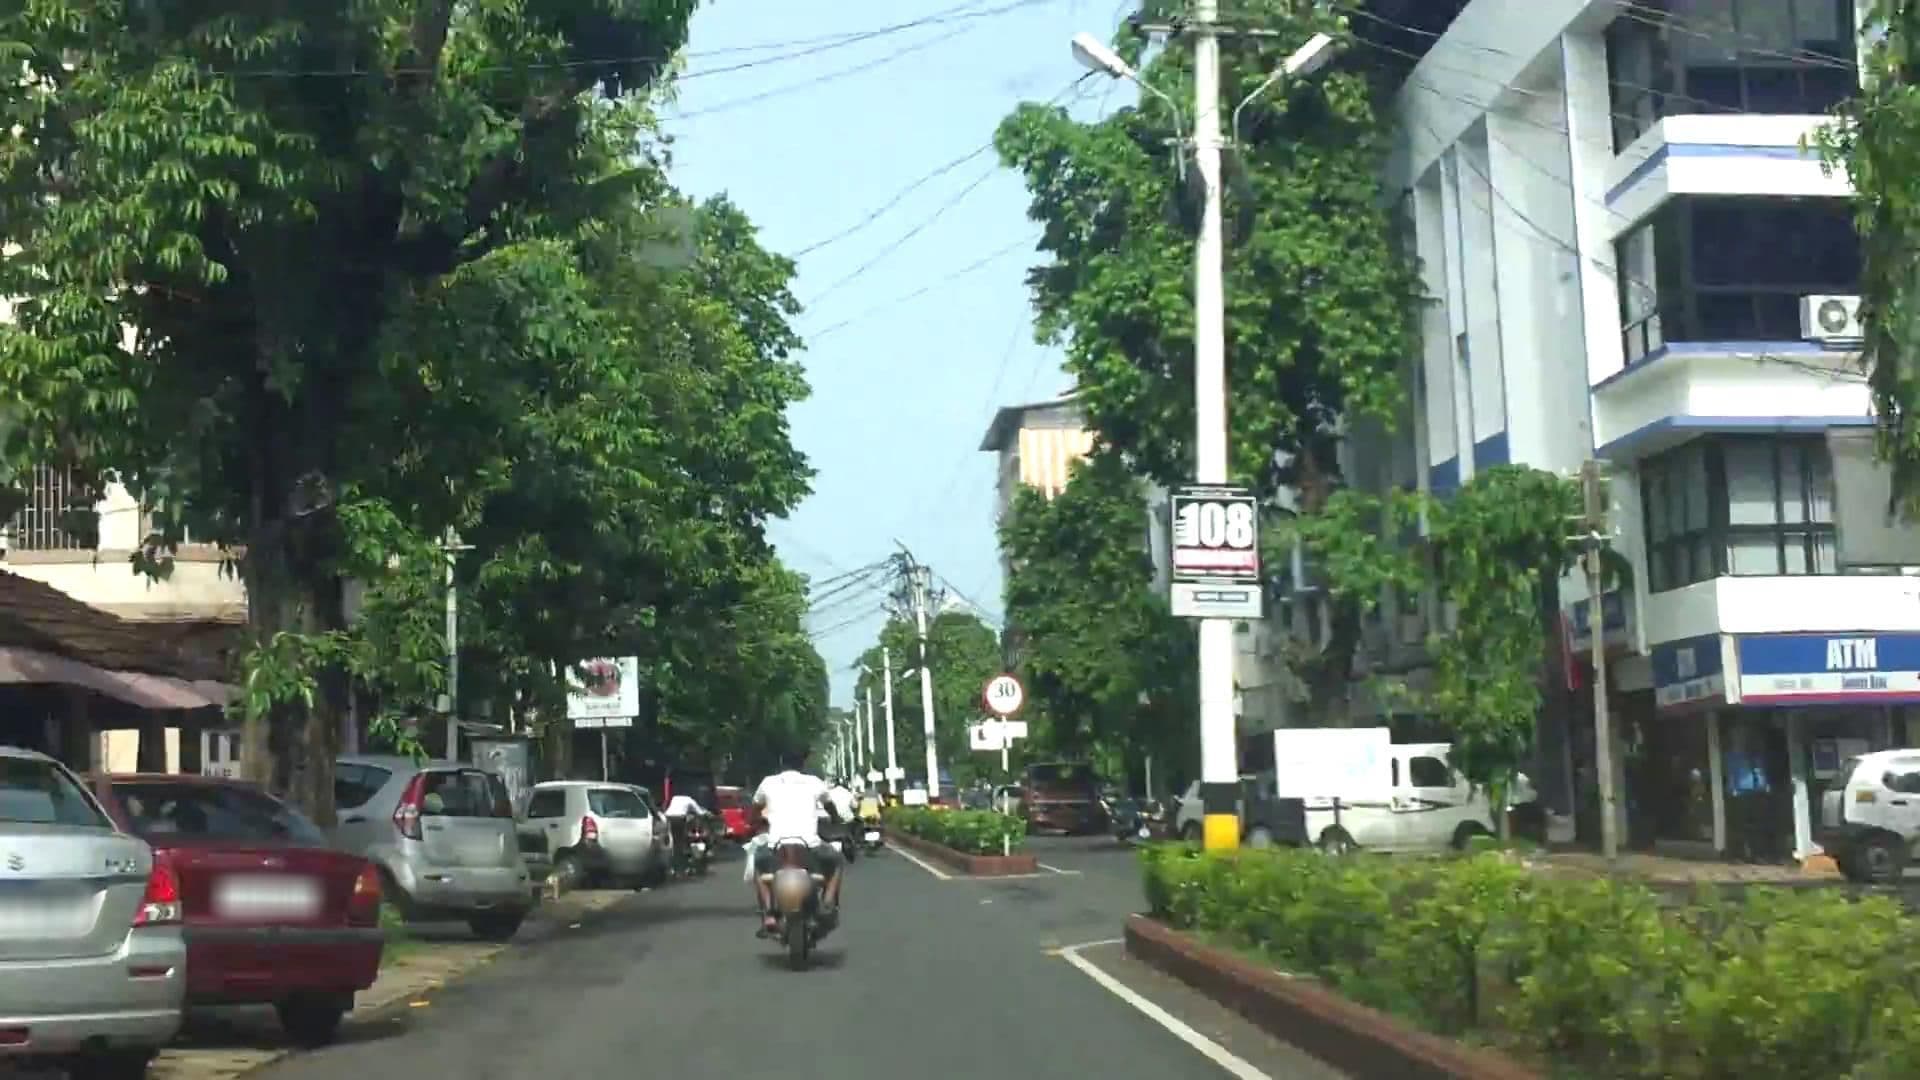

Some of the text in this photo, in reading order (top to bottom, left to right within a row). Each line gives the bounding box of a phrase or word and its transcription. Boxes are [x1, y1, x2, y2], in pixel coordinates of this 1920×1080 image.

[1177, 502, 1253, 549] 108
[1826, 637, 1878, 669] ATM
[994, 682, 1016, 698] 30
